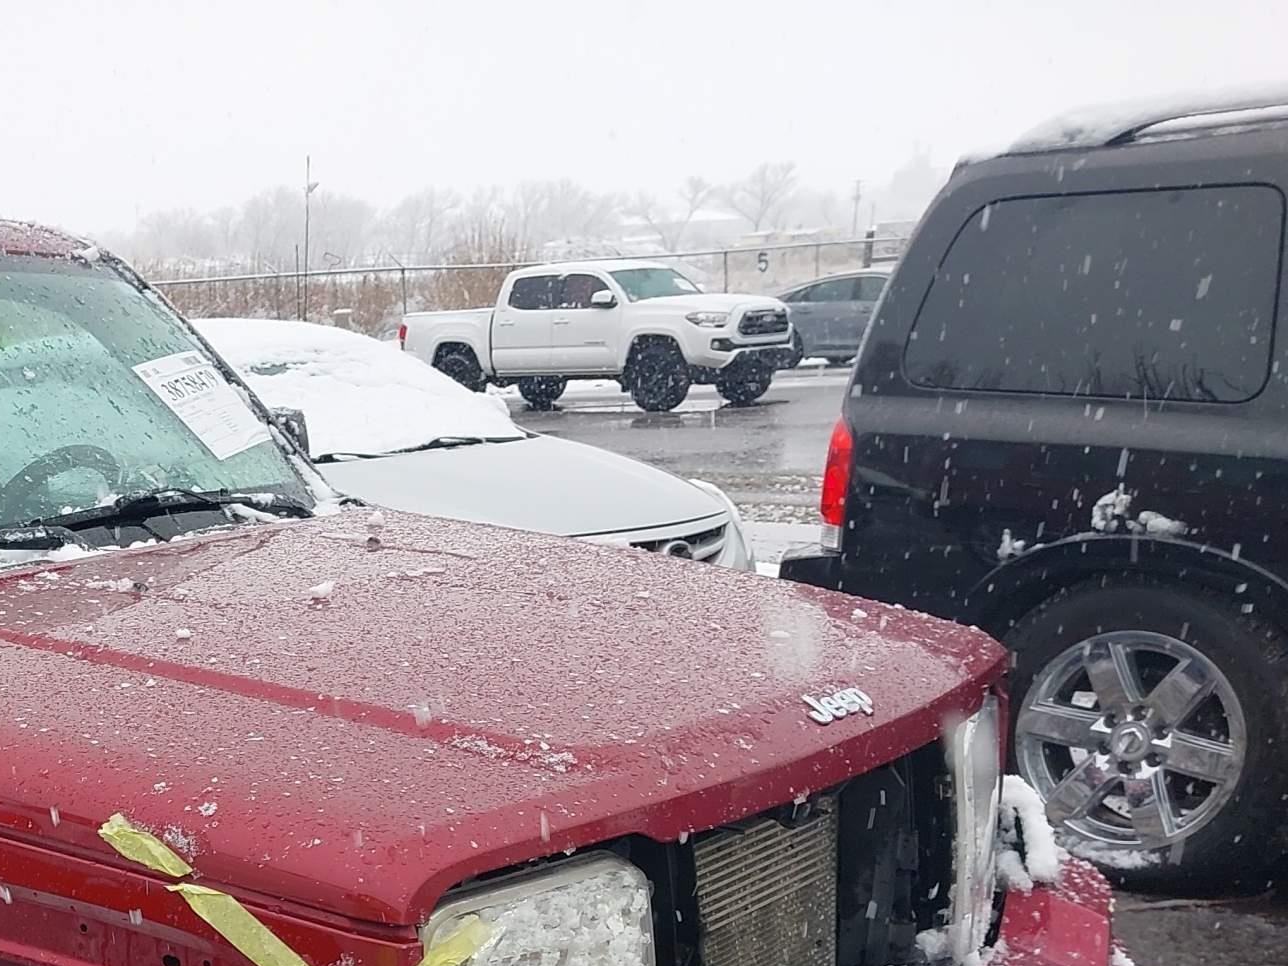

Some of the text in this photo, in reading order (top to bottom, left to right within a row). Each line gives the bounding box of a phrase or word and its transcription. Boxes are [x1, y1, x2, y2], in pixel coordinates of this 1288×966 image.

[758, 252, 768, 272] 5
[161, 369, 217, 401] 38758479
[800, 688, 874, 724] Jeep
